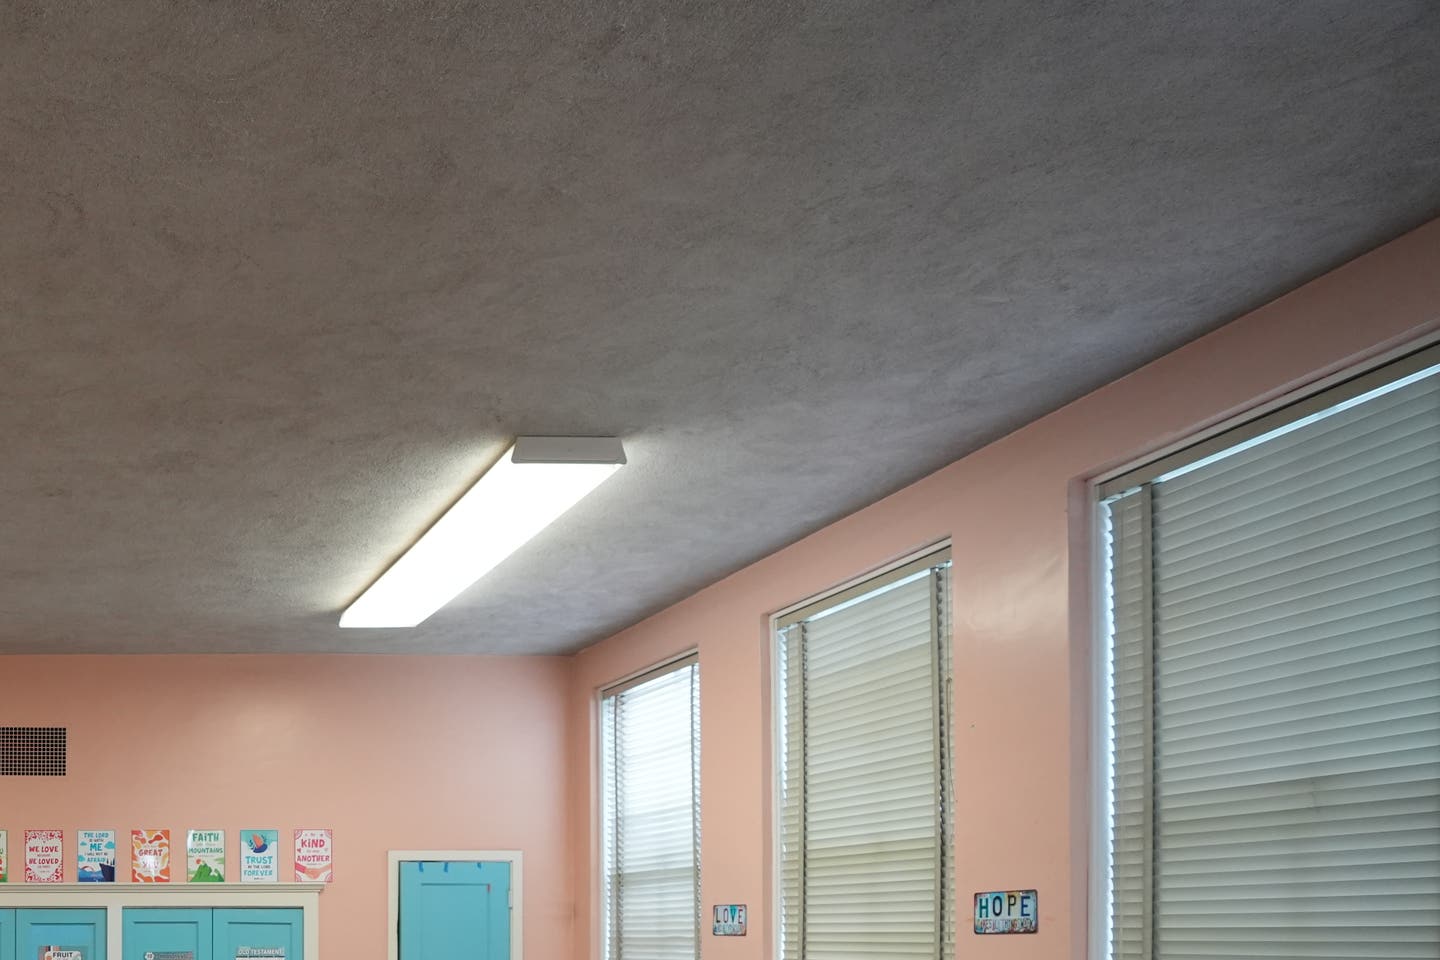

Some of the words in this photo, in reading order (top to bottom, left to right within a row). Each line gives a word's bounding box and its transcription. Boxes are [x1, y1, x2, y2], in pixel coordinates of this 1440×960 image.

[89, 843, 103, 851] ME
[244, 856, 273, 865] TRUST
[979, 895, 1031, 918] HOPE
[715, 908, 743, 924] LOVE
